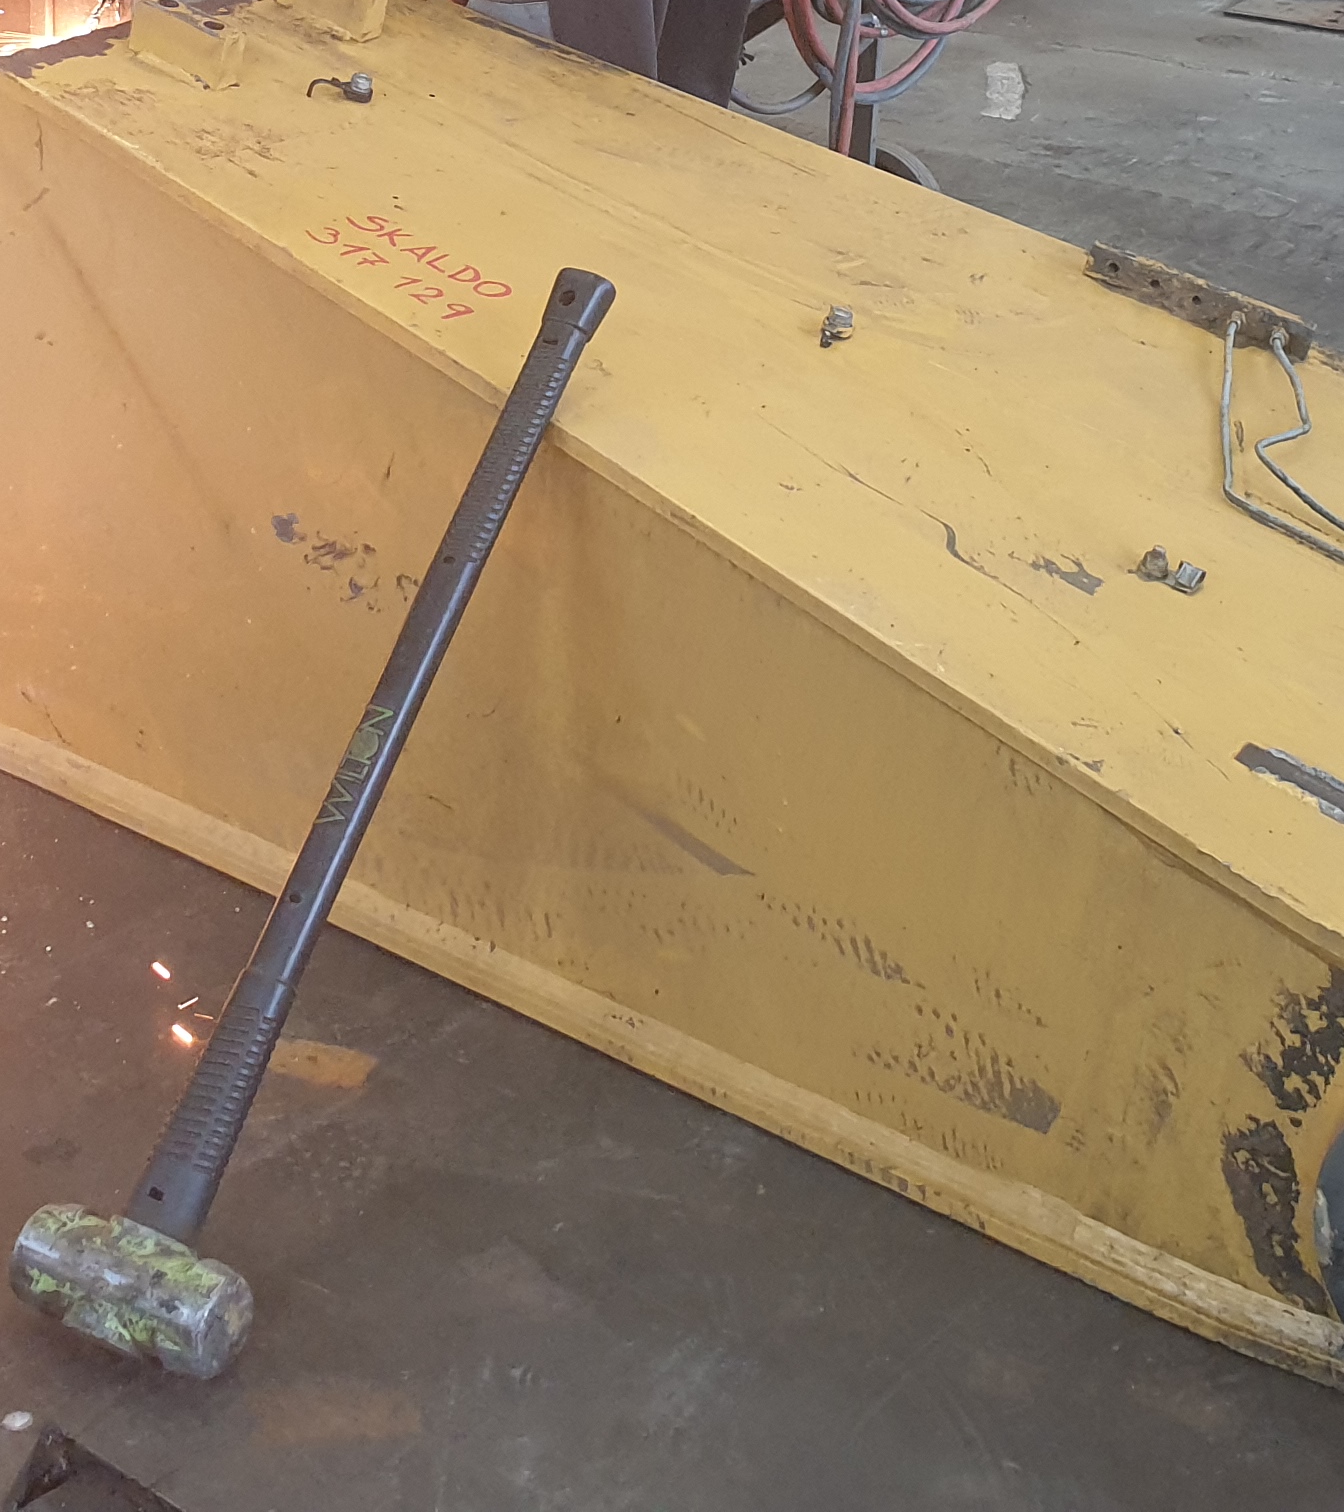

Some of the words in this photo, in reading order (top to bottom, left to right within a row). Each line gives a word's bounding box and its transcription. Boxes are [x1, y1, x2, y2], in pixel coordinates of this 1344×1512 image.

[305, 226, 390, 267] 317
[393, 275, 475, 320] 129
[346, 214, 513, 299] SKALDO
[313, 703, 395, 825] WILTON
